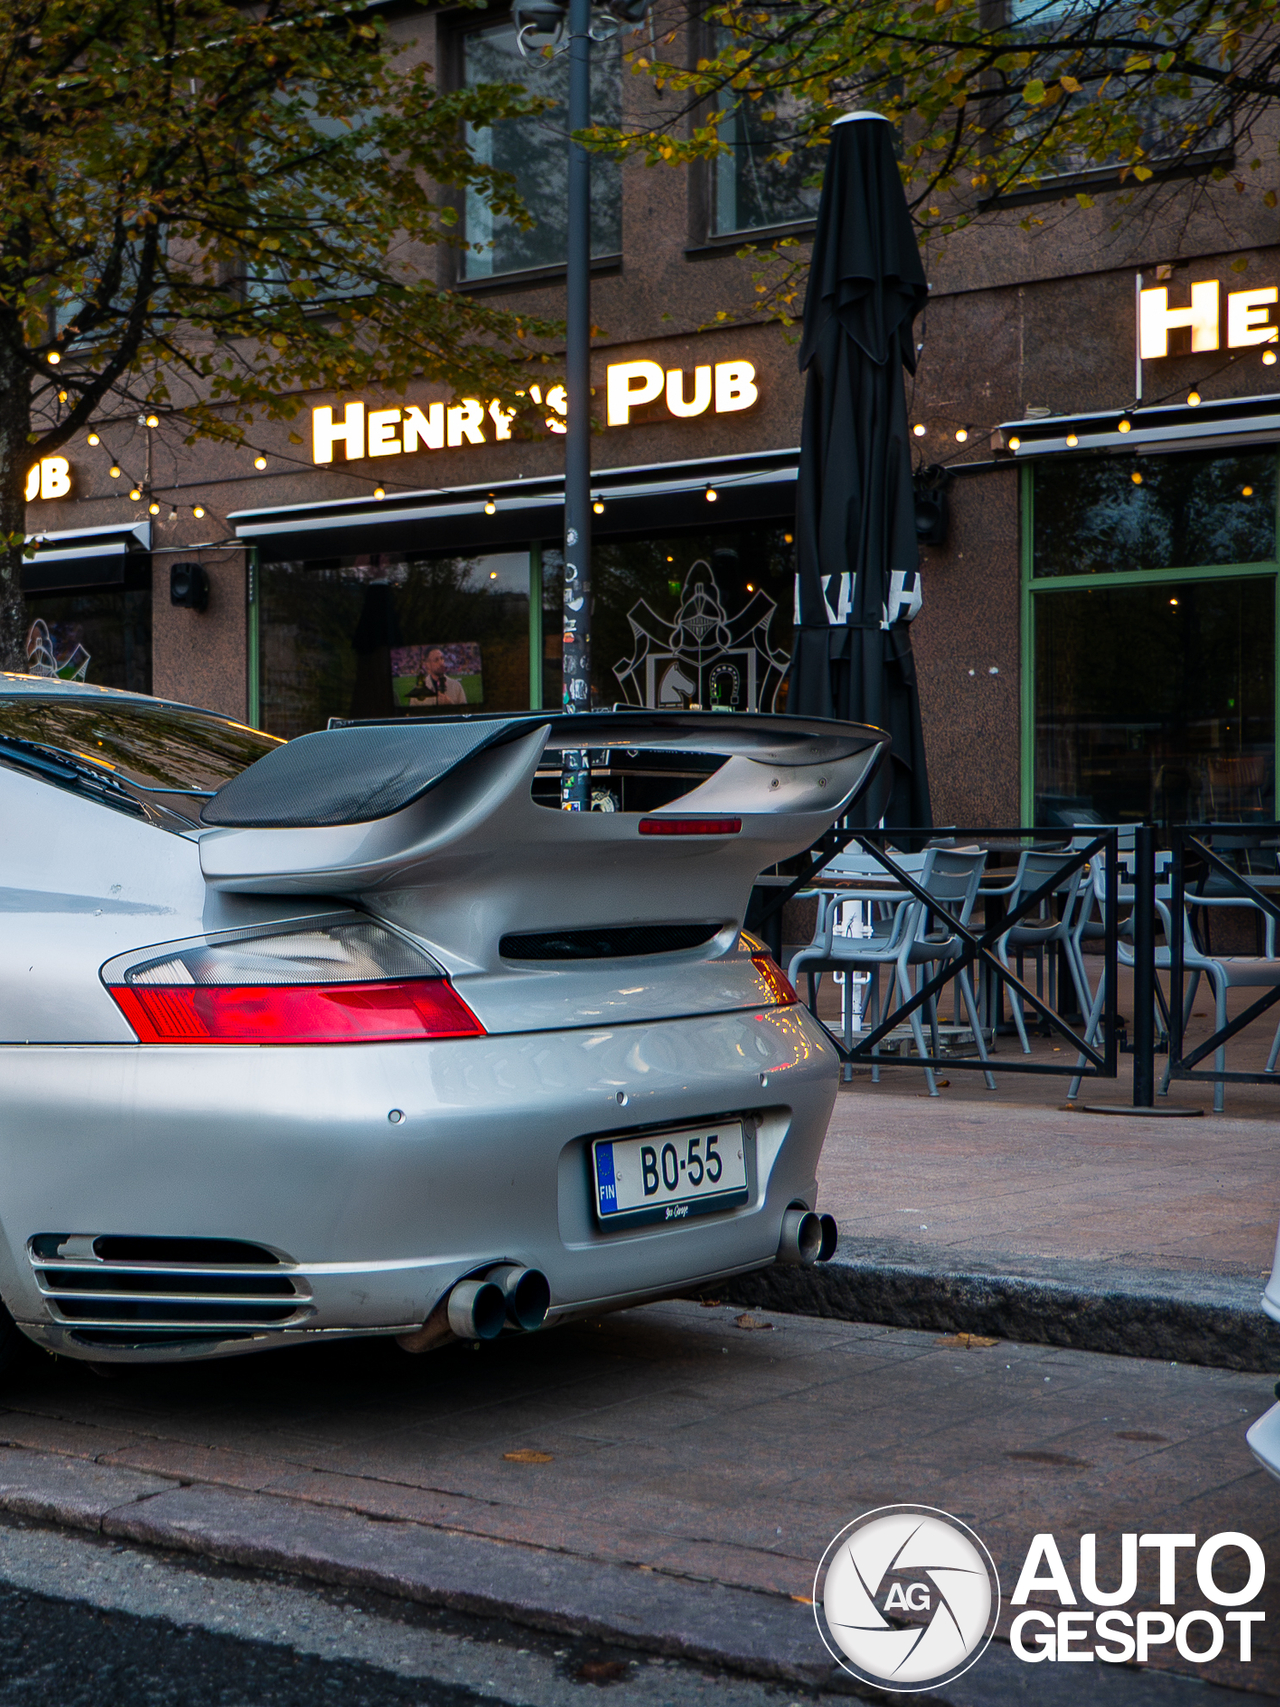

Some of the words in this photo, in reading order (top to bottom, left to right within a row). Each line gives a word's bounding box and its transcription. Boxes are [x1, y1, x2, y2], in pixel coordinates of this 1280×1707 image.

[607, 359, 759, 427] PUB
[599, 1184, 615, 1200] FIN
[640, 1135, 723, 1196] BO-55
